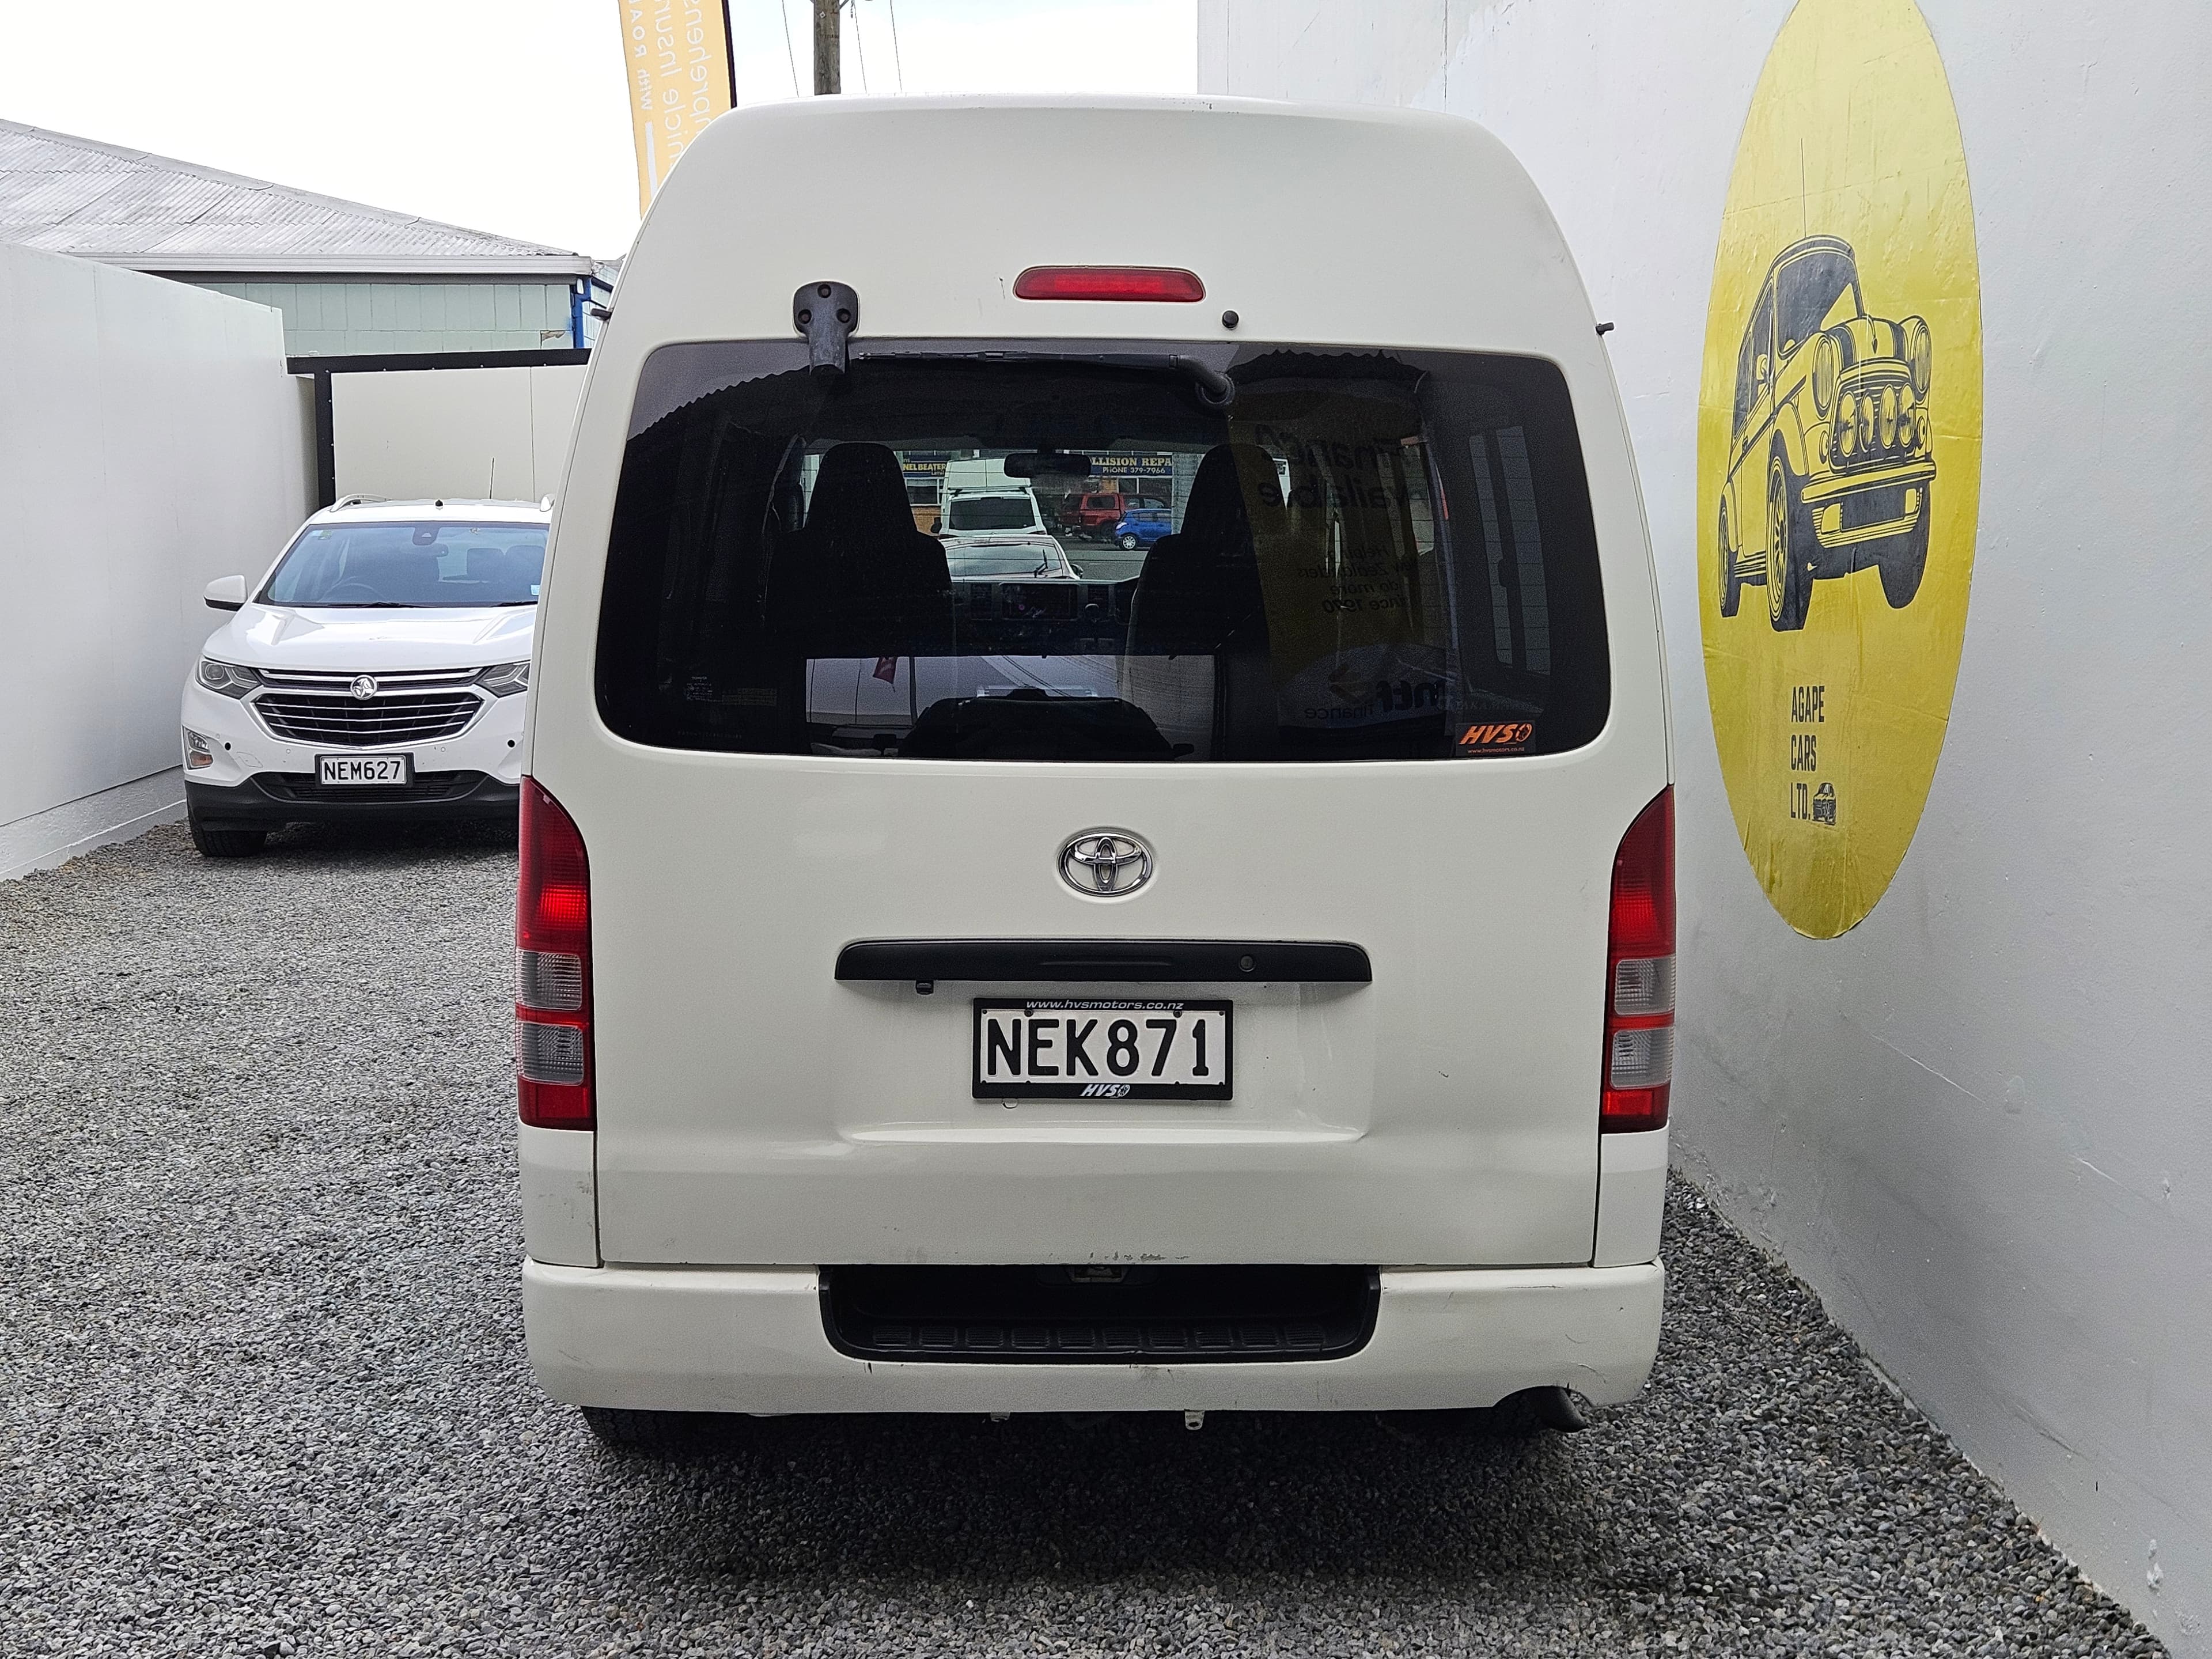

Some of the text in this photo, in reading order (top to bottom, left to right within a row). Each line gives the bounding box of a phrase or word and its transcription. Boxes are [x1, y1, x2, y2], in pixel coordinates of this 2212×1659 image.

[1091, 457, 1172, 467] LLISION REPA
[1791, 685, 1825, 722] AGAPE
[324, 760, 401, 781] NEM627
[1790, 734, 1817, 772] CARS
[1790, 782, 1811, 821] LTD.
[1026, 999, 1184, 1010] www.hvsmotors.co.nz
[987, 1018, 1209, 1077] NEK871
